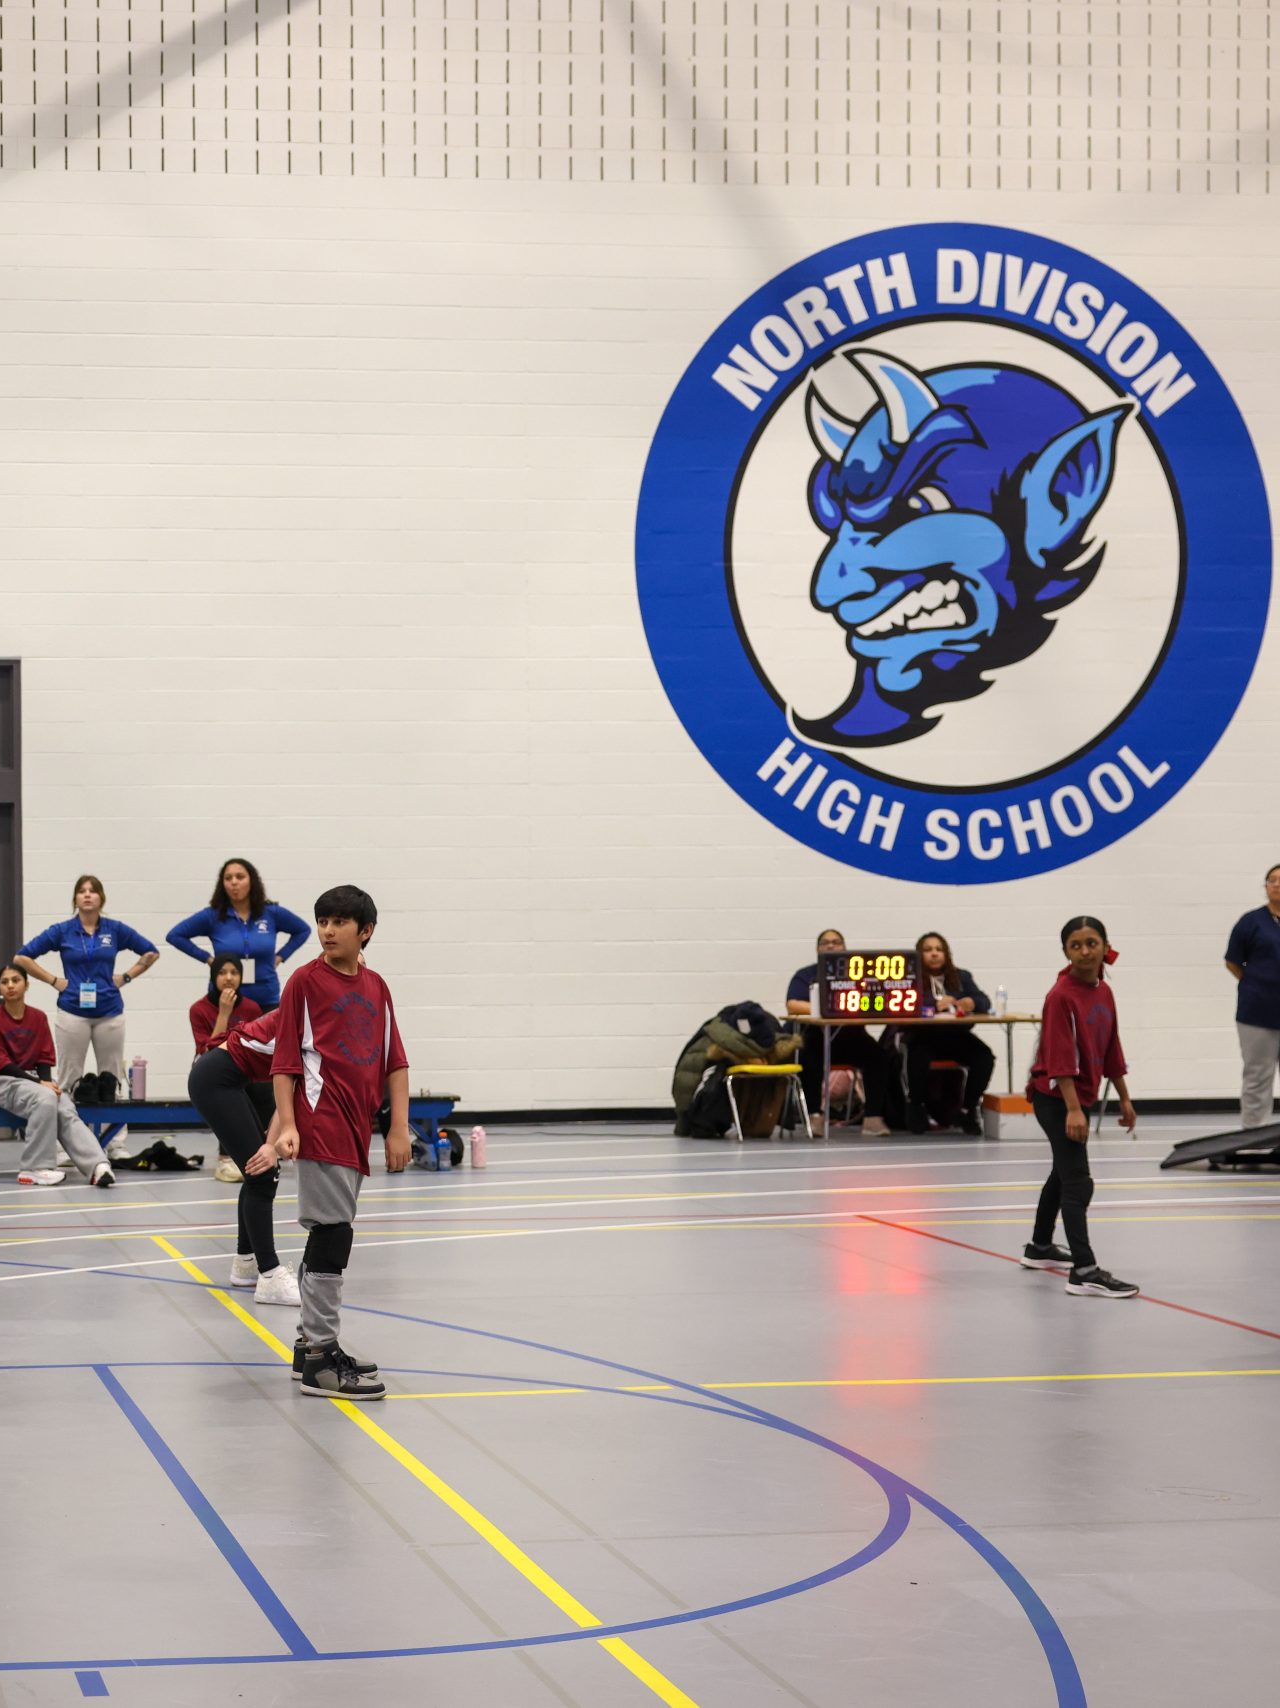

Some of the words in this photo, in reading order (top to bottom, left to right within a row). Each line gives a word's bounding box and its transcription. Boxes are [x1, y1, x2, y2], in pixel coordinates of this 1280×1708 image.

[712, 252, 918, 411] NORTH
[936, 248, 1197, 418] DIVISION
[756, 737, 905, 852] HIGH
[923, 745, 1171, 861] SCHOOL
[848, 955, 905, 980] 0:00
[830, 981, 856, 991] HOME
[883, 980, 913, 990] GUEST
[839, 990, 861, 1012] 18
[889, 989, 917, 1012] 22
